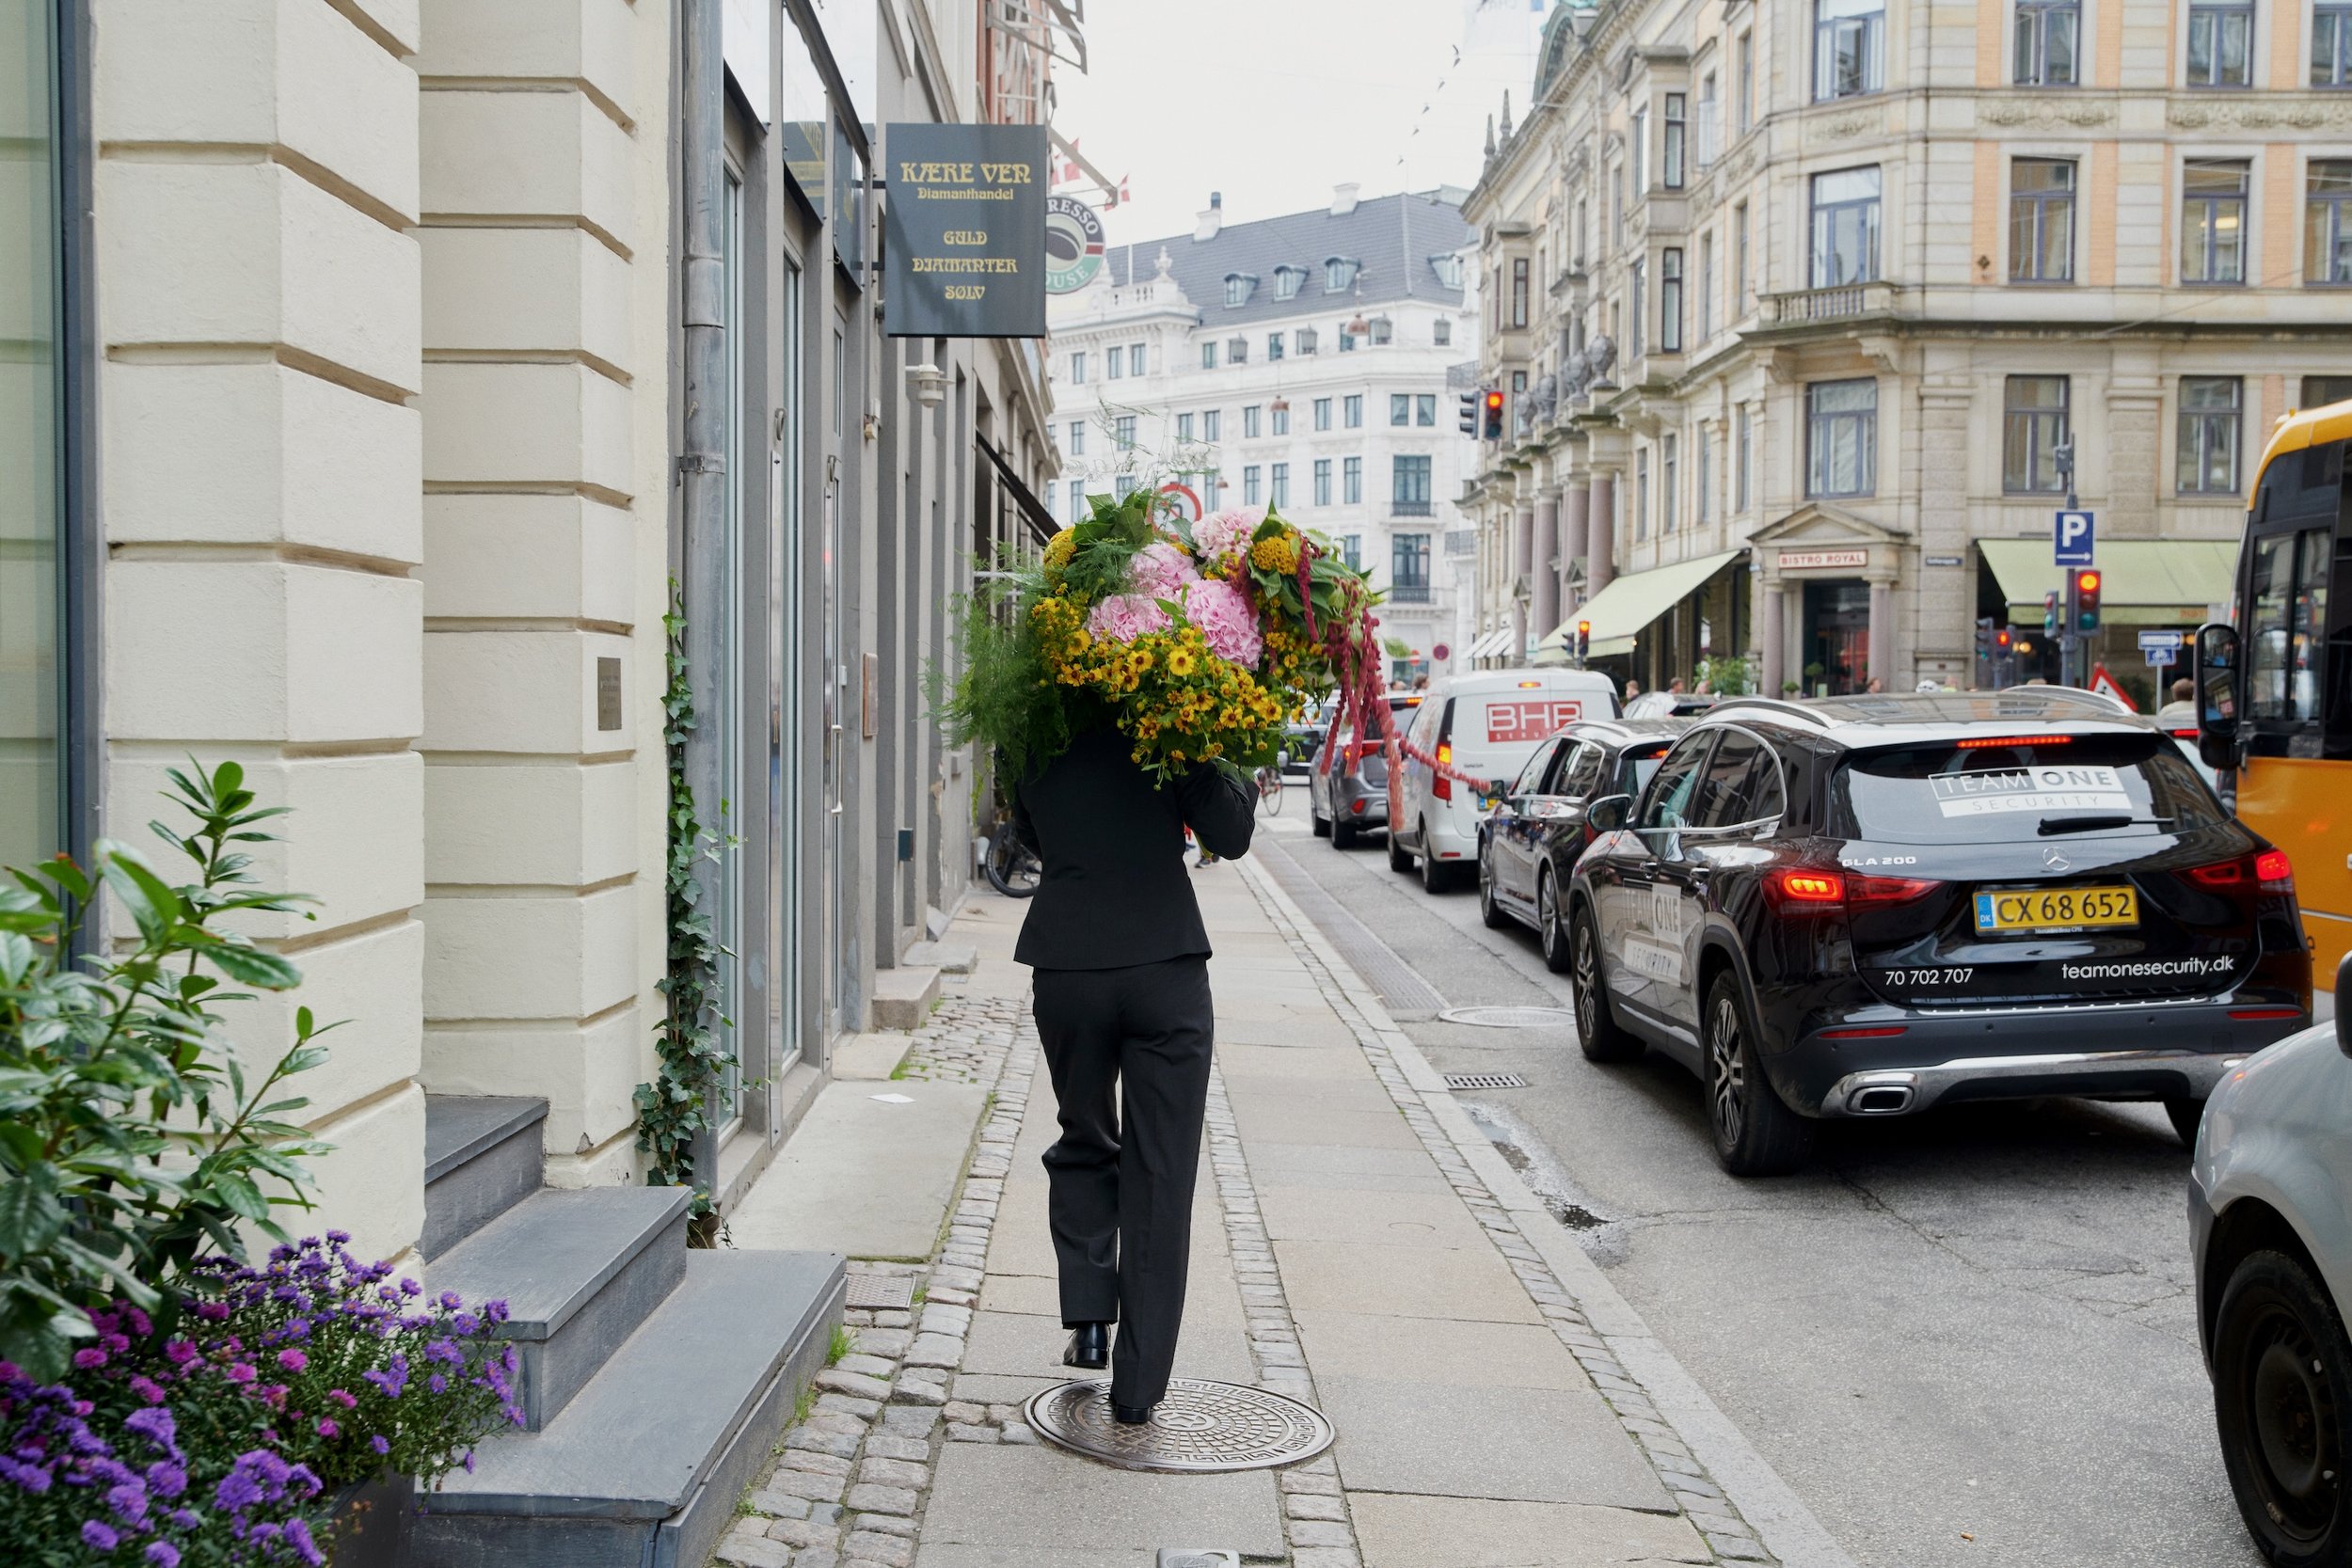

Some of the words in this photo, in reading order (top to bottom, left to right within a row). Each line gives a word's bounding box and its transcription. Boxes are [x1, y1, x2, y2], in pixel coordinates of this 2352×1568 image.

[900, 162, 975, 183] KÆRE
[980, 163, 1032, 184] VEN
[917, 187, 1014, 200] Diamanthandel
[1046, 198, 1100, 235] RESSO
[944, 230, 988, 245] GULD
[912, 258, 1019, 274] DIAMANTER
[945, 285, 986, 300] SØLV
[2061, 514, 2088, 548] P
[1781, 555, 1822, 564] BISTRO
[1826, 554, 1862, 563] ROYAL
[1939, 771, 2029, 794] TEAM
[2041, 771, 2112, 786] ONE
[1972, 795, 2099, 812] SECURITY
[1841, 857, 1878, 867] GLA
[1882, 855, 1917, 865] 200
[1656, 895, 1679, 934] ONE
[1996, 896, 2033, 923] CX
[2041, 895, 2074, 920] 68
[2081, 892, 2132, 919] 652
[1979, 913, 1992, 923] DK
[1632, 946, 1673, 977] SECURITY
[2061, 956, 2234, 980] teamonesecurity.dk
[1884, 971, 1906, 986] 70
[1910, 970, 1940, 985] 702
[1944, 968, 1974, 984] 707
